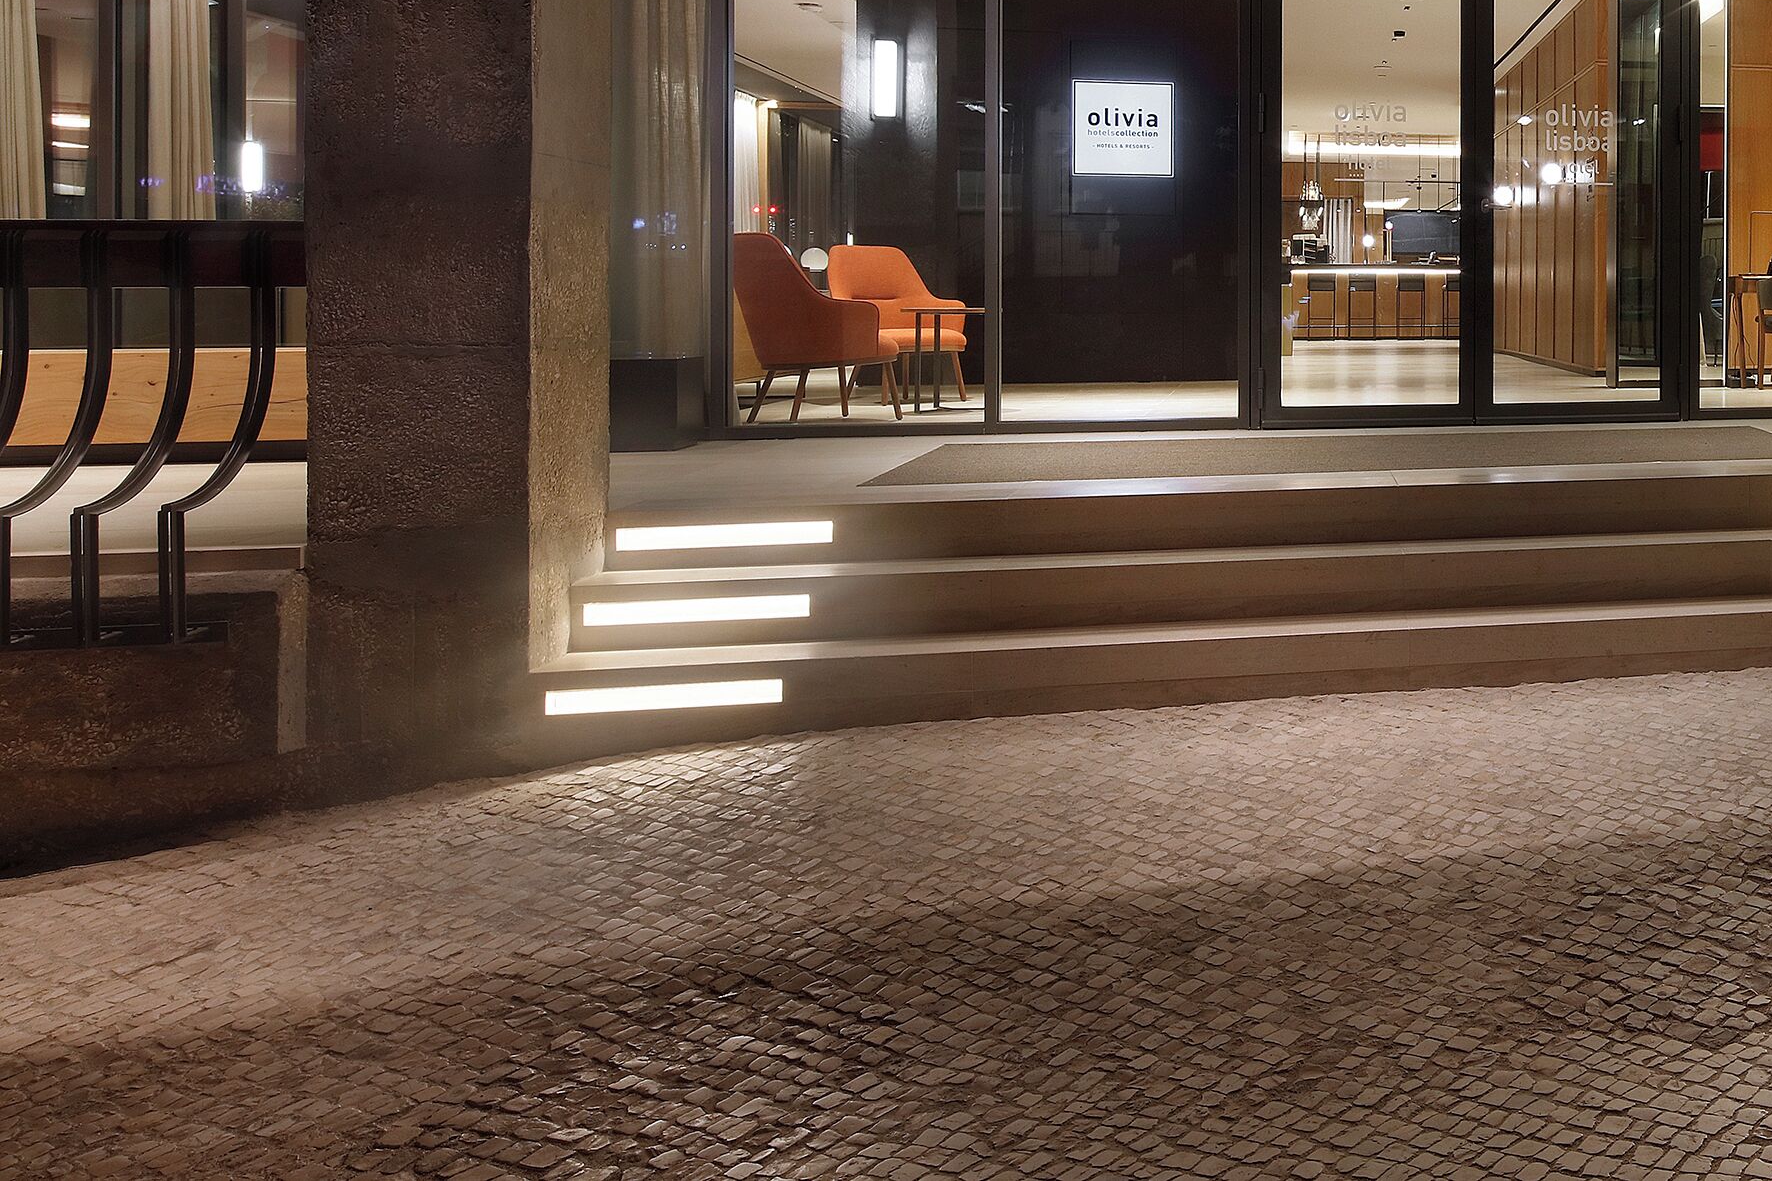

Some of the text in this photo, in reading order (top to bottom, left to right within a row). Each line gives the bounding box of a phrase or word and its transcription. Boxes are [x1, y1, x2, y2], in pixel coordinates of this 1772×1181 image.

[1087, 107, 1159, 128] olivia
[1334, 99, 1407, 122] olivia
[1545, 103, 1614, 128] olivia
[1335, 124, 1407, 147] lisboa
[1546, 129, 1611, 152] lisboa
